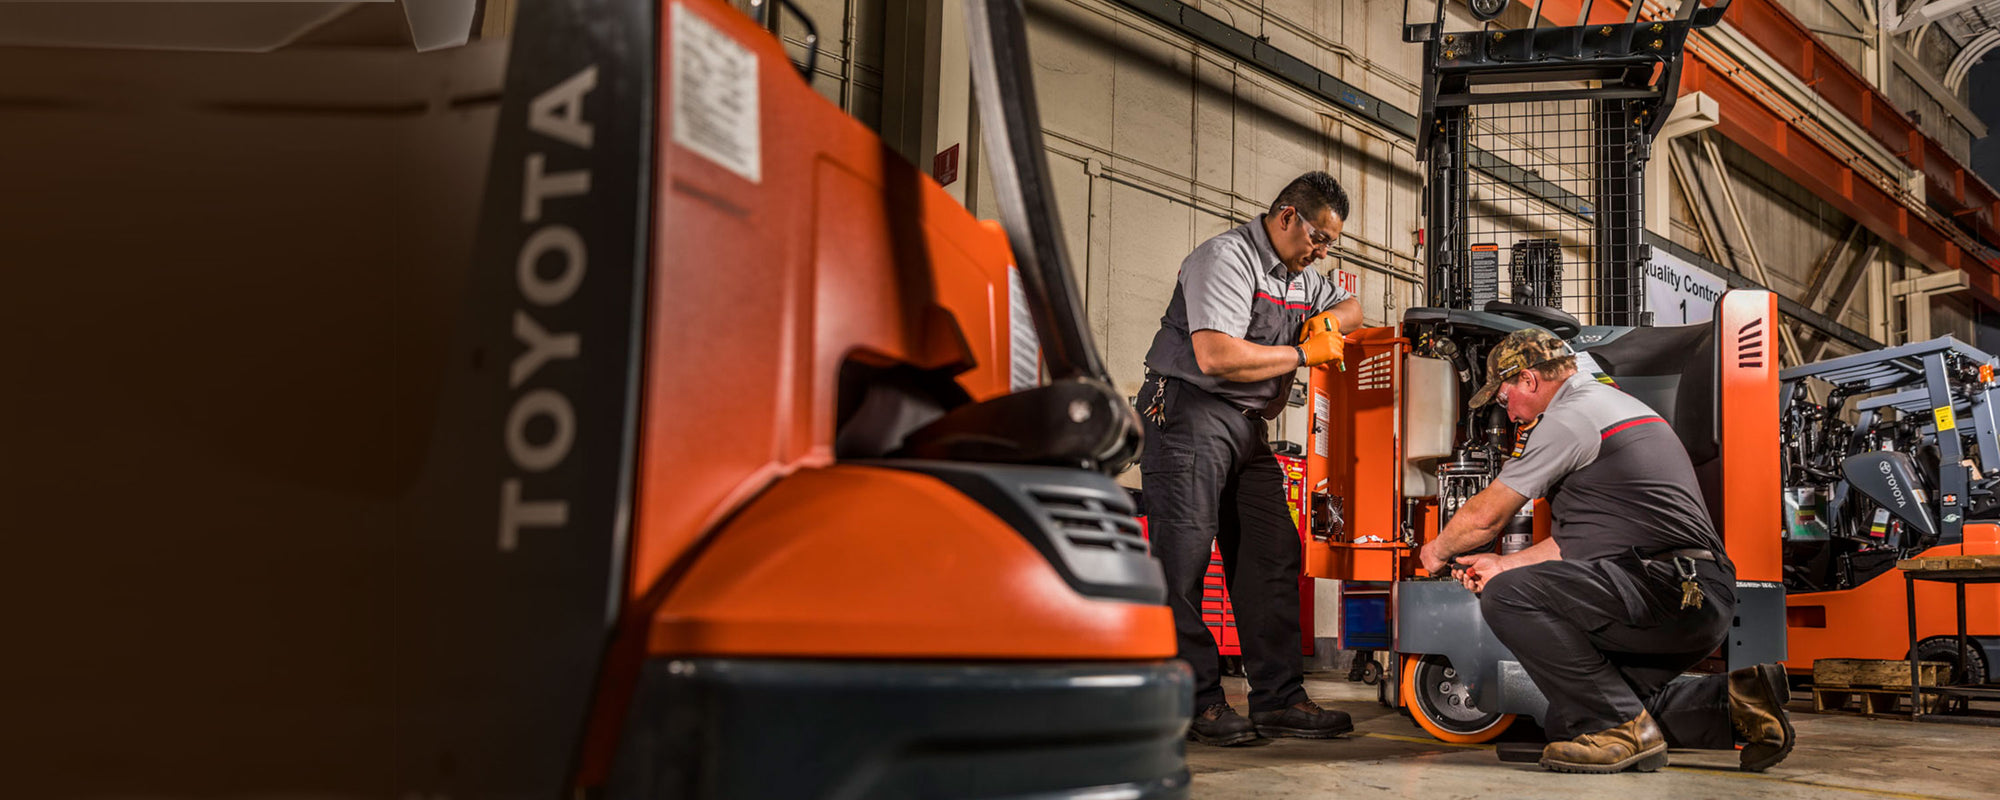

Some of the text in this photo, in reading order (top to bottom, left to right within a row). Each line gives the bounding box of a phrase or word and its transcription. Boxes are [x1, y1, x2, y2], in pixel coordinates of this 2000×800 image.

[1339, 270, 1357, 294] EXIT
[499, 66, 598, 550] TOYOTA
[1680, 299, 1687, 324] 1
[1886, 473, 1906, 508] TOYOTA
